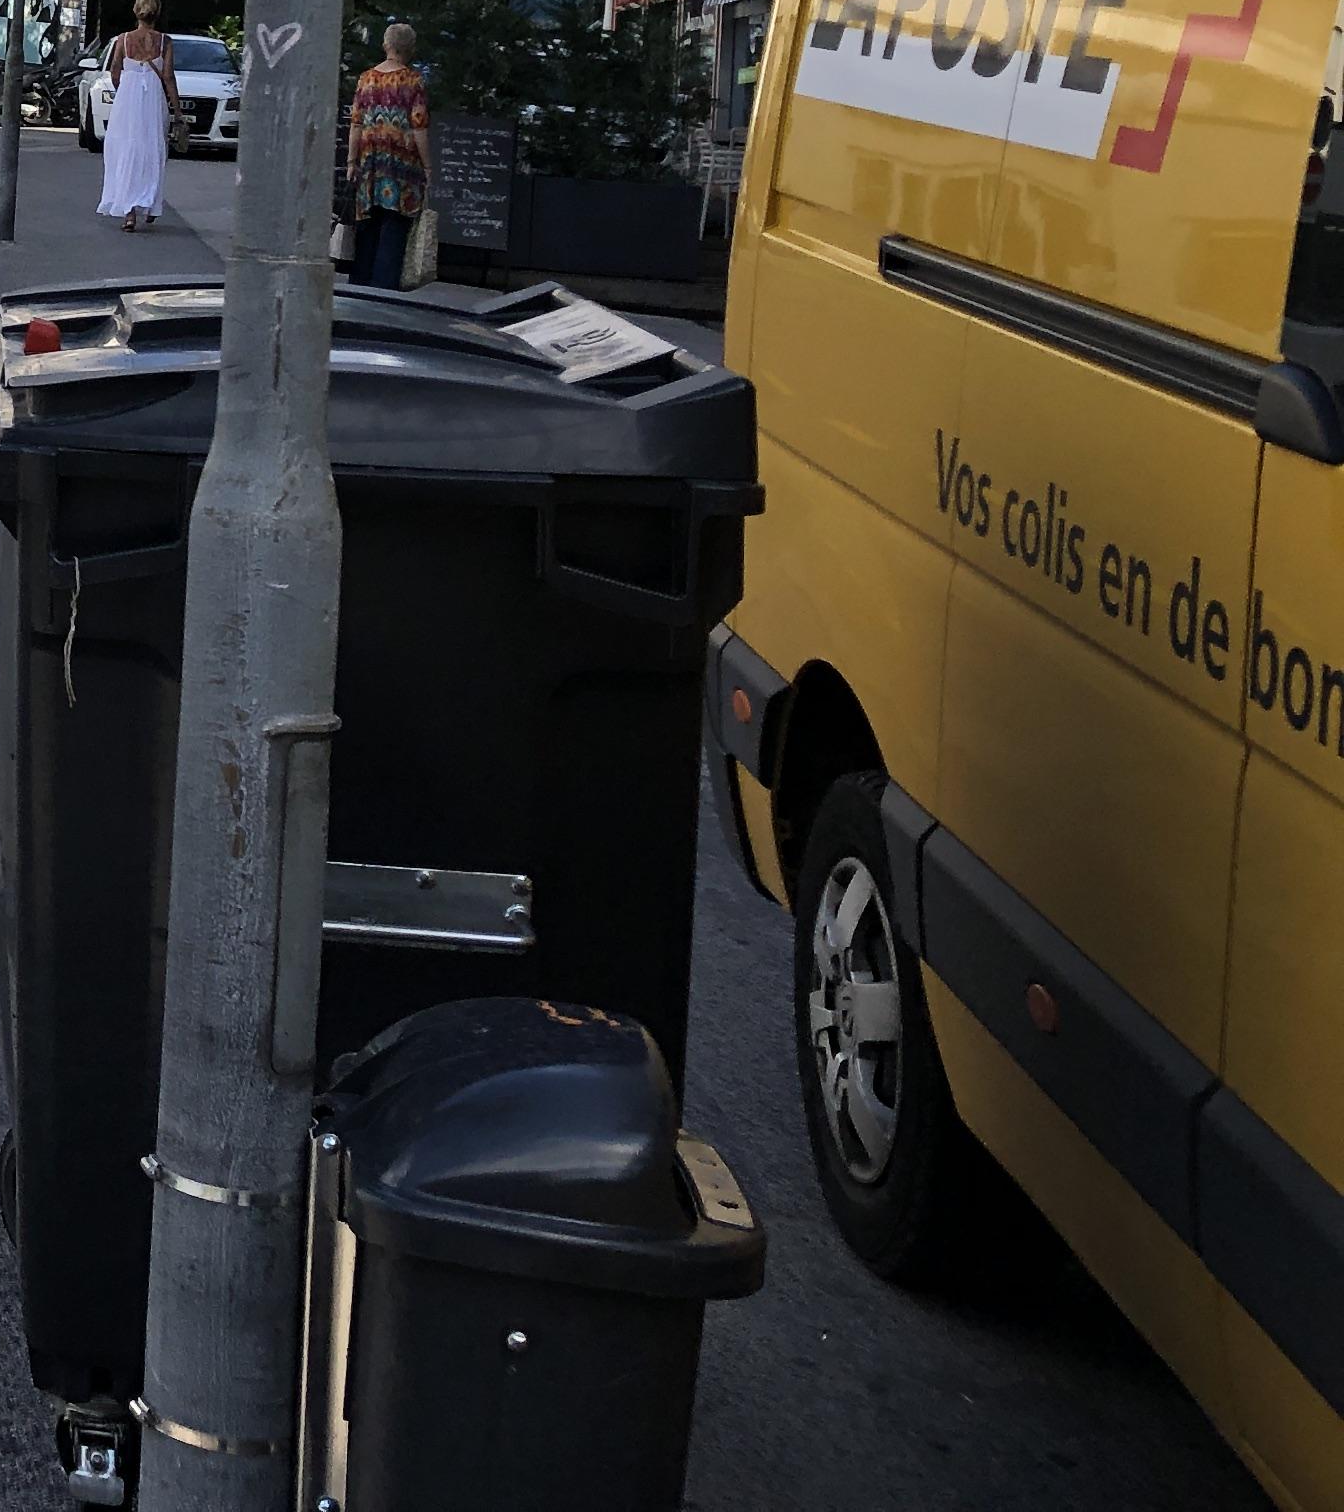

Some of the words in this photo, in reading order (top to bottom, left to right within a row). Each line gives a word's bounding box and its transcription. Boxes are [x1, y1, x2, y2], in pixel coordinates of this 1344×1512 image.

[935, 427, 992, 538] Vos
[1002, 482, 1086, 595] colis
[1099, 543, 1152, 637] en
[1167, 556, 1230, 682] de
